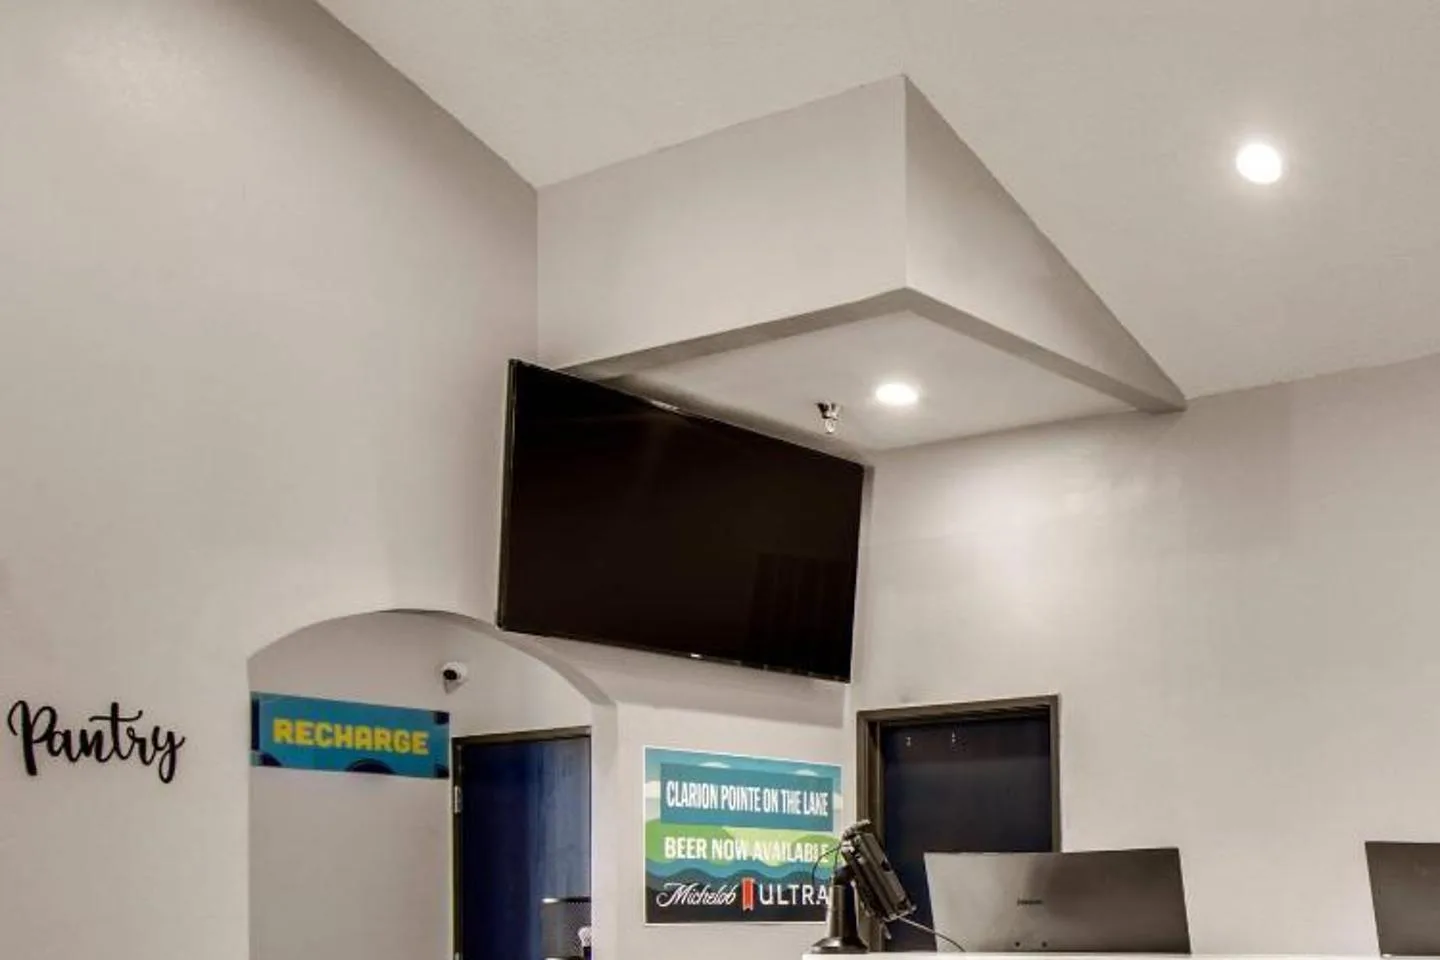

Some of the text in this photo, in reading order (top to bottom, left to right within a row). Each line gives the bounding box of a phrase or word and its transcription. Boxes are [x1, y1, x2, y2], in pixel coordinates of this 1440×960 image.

[7, 700, 186, 784] Pantry
[272, 718, 430, 756] RECHARGE
[666, 780, 829, 817] CLARION POINTE ON THE LAKE
[664, 836, 829, 863] BEER NOW AVAILABLE
[656, 882, 830, 907] Michelob ULTRA
